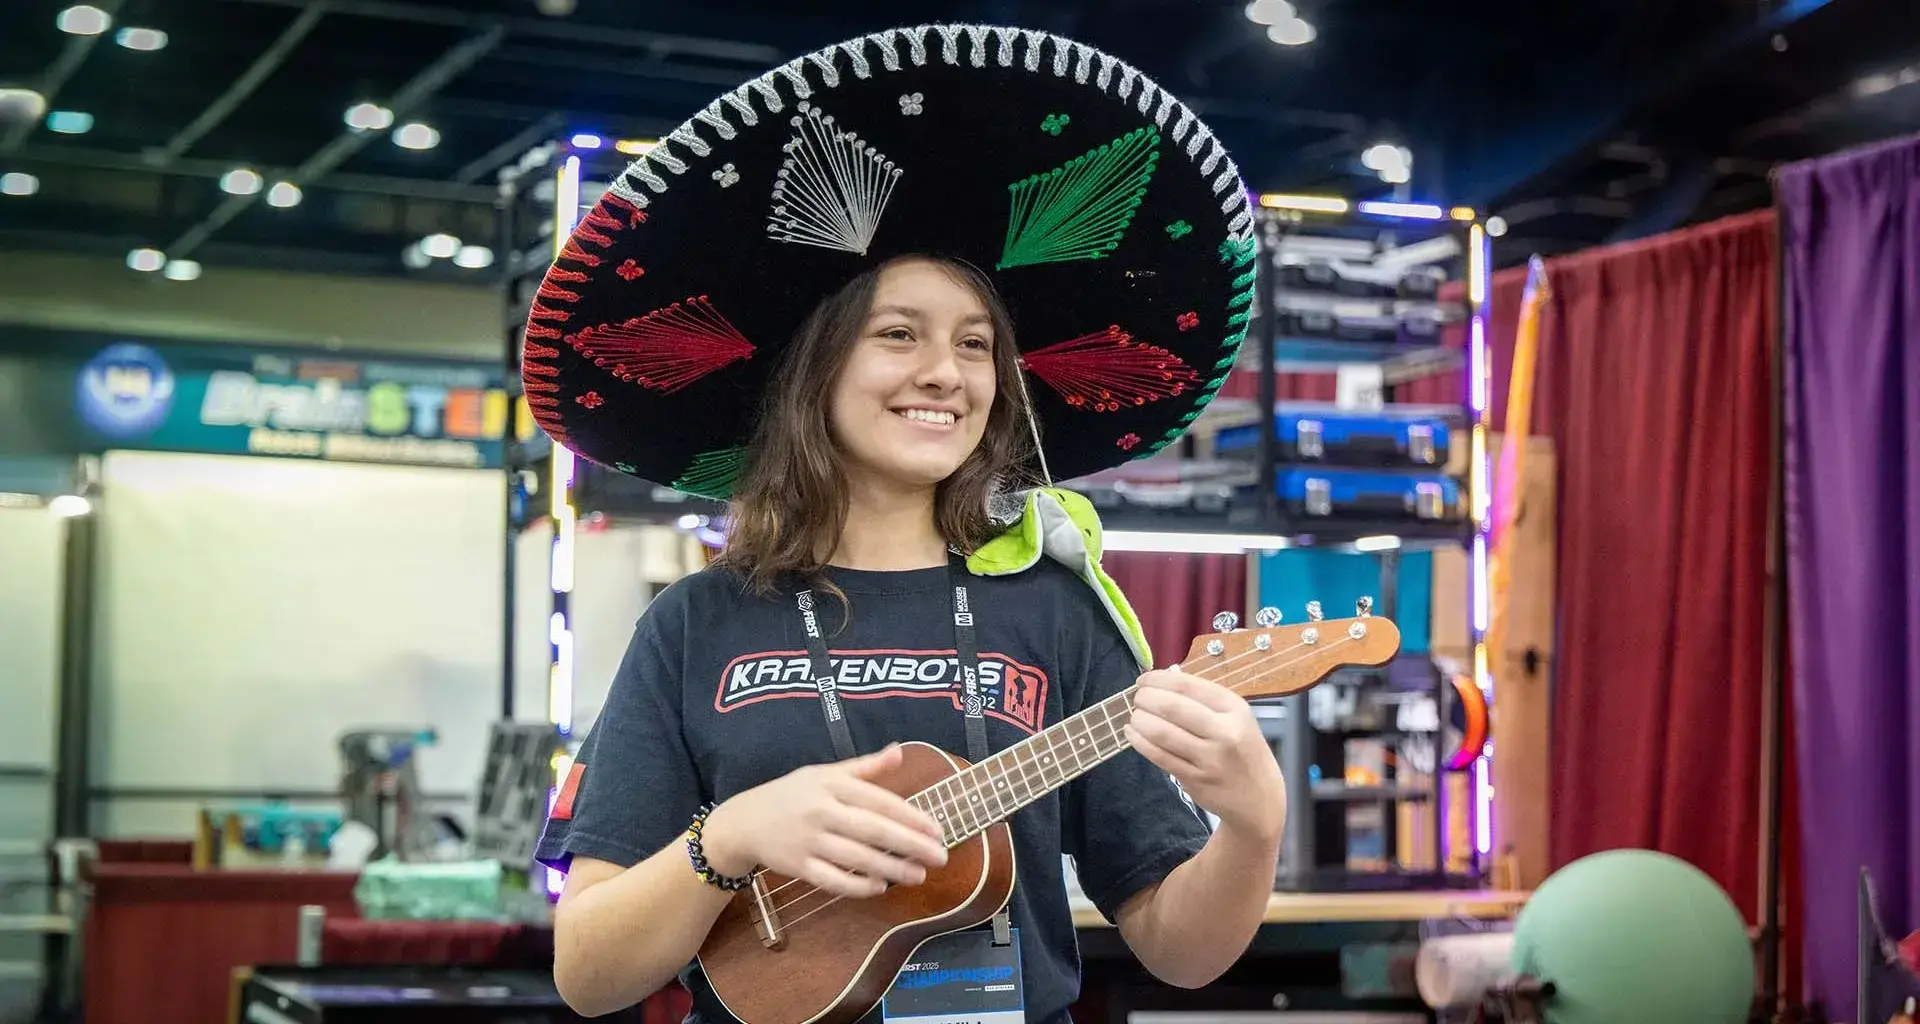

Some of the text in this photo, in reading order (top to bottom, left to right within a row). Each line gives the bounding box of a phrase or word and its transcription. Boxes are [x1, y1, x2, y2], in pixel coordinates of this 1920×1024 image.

[955, 586, 964, 612] MOUSER
[803, 610, 820, 638] FIRST
[963, 665, 978, 696] FIRST
[827, 690, 841, 721] MOUSER
[921, 961, 940, 971] 2025
